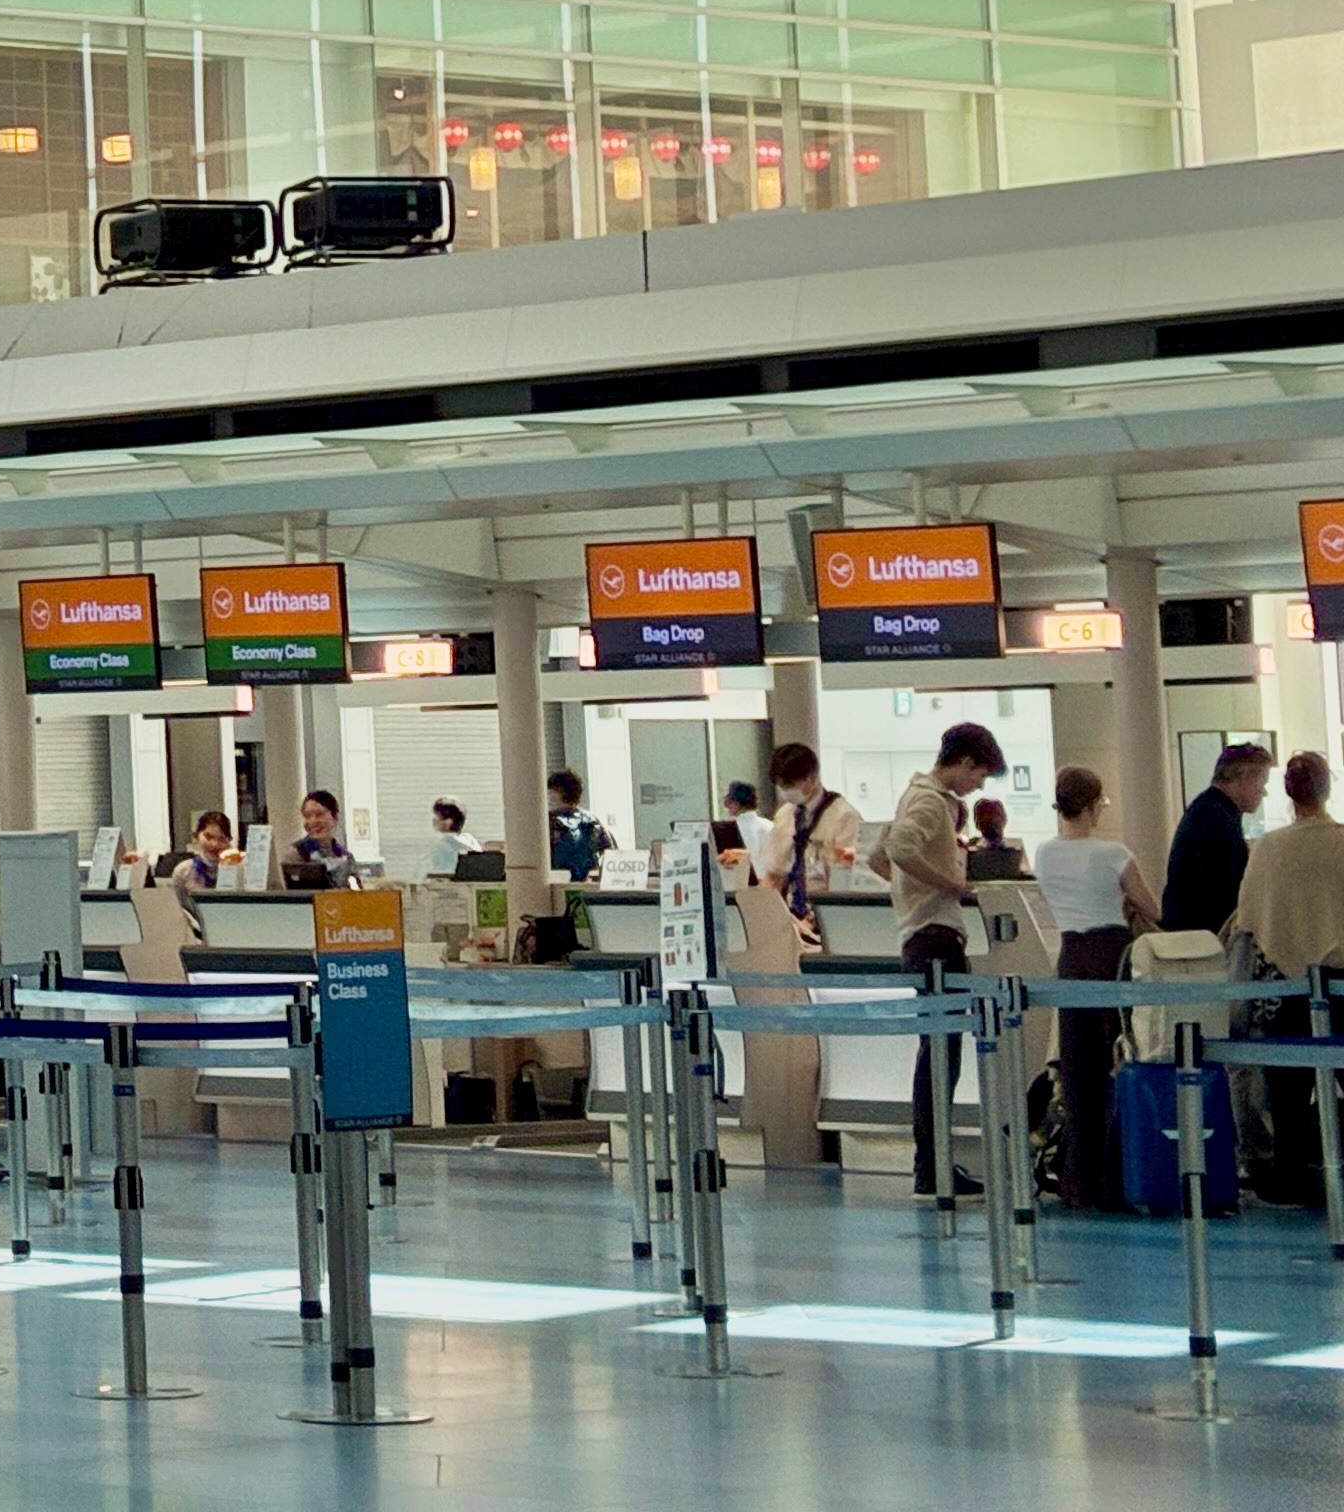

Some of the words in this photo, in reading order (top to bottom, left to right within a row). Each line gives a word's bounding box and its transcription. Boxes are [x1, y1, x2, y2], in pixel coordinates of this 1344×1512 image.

[868, 555, 979, 581] Lufthansa
[638, 567, 741, 592] Lufthansa
[244, 590, 330, 614] Lufthansa
[60, 601, 142, 623] Lufthansa
[642, 626, 669, 645] Bag
[670, 624, 704, 643] Drop
[873, 616, 902, 636] Bag
[904, 615, 940, 635] Drop
[1058, 622, 1092, 641] C-6
[232, 645, 283, 662] Economy
[284, 643, 316, 659] Class
[397, 649, 425, 668] C-8
[864, 645, 889, 656] STAR
[891, 643, 940, 655] ALLIANCE
[49, 654, 98, 670] Economy
[99, 652, 129, 667] Class
[605, 860, 647, 873] CLOSED
[324, 926, 395, 944] Lufthansa
[327, 961, 389, 979] Business
[328, 983, 368, 1000] Class
